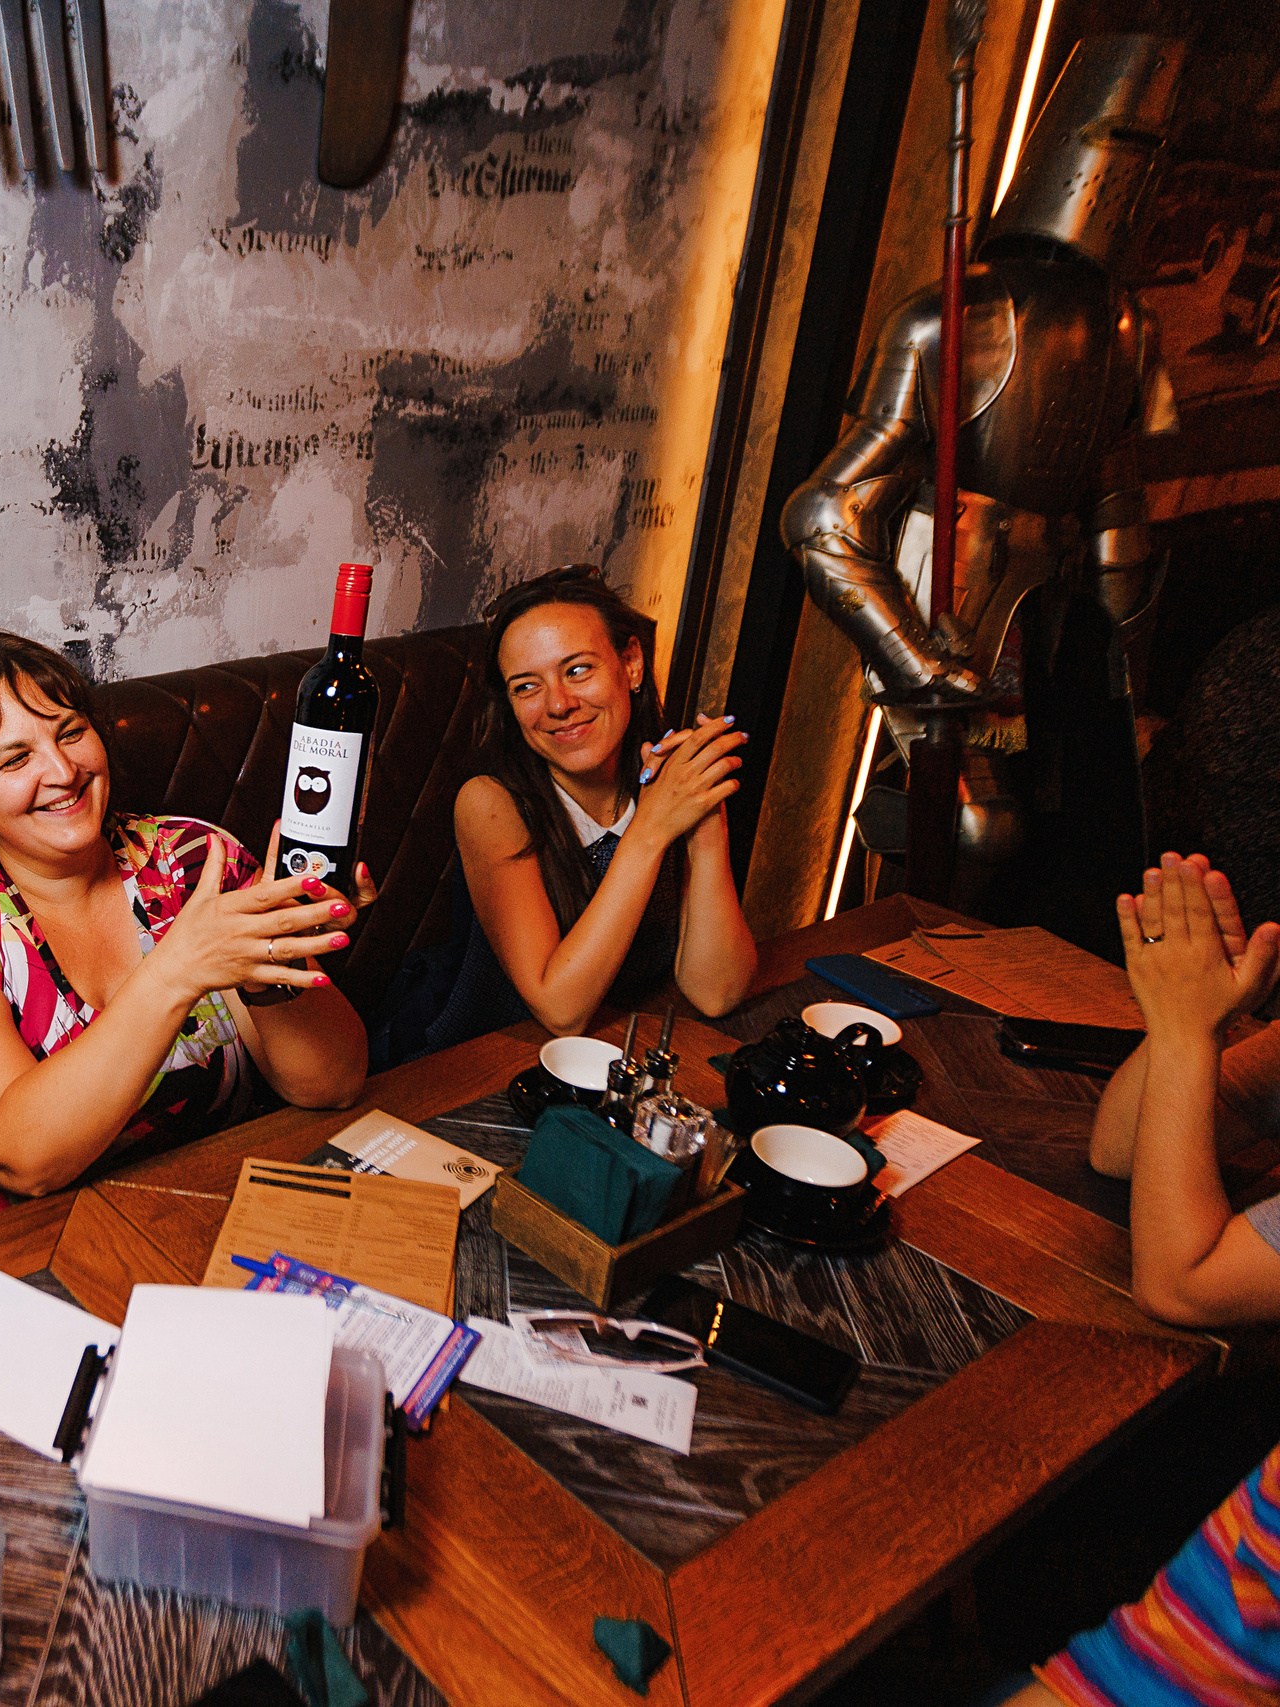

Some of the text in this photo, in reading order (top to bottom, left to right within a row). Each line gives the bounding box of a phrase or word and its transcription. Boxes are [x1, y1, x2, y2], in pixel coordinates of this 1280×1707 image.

[293, 739, 349, 759] DEL MORAL
[301, 735, 342, 749] ABADÍA
